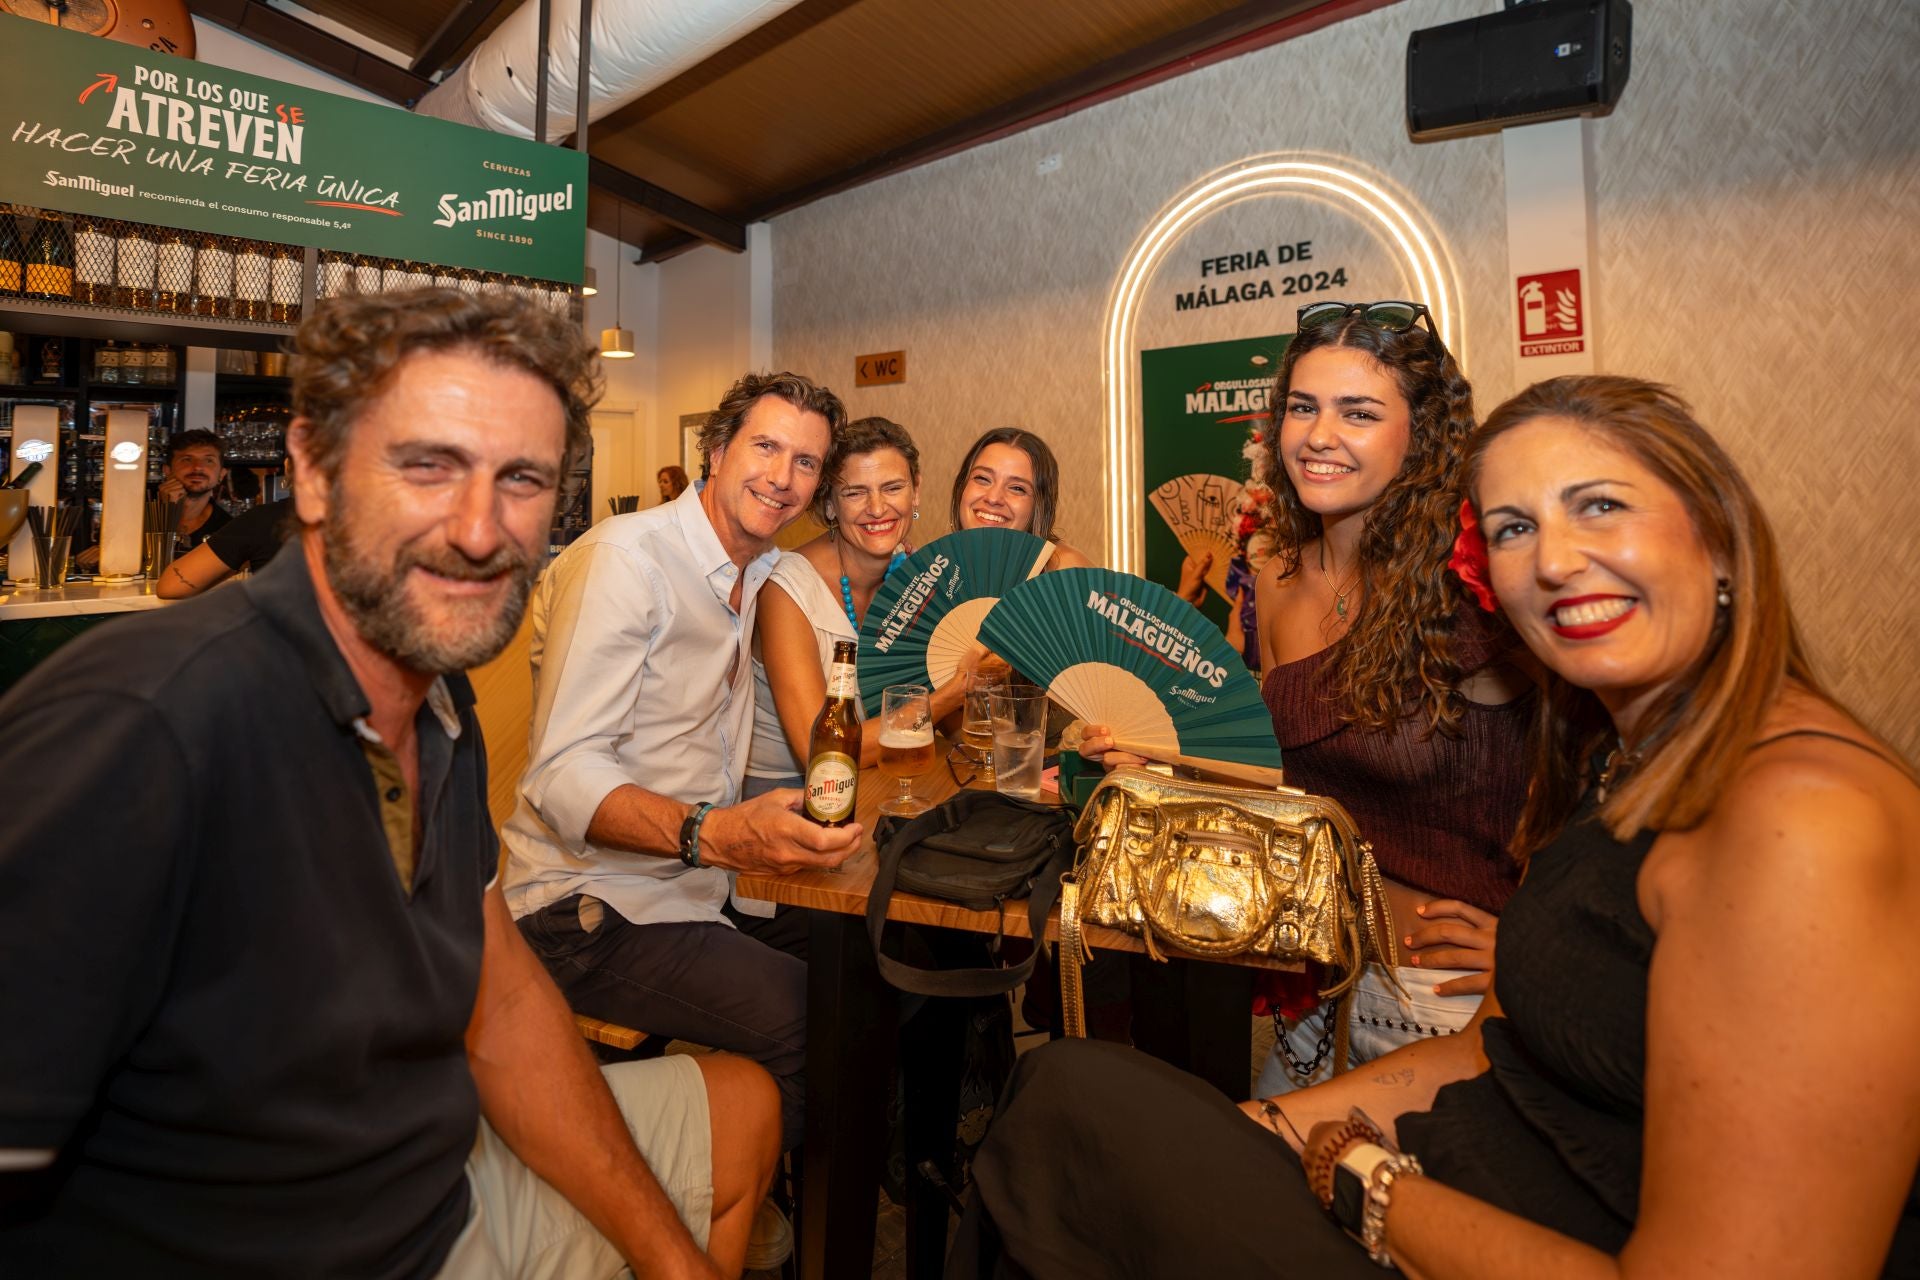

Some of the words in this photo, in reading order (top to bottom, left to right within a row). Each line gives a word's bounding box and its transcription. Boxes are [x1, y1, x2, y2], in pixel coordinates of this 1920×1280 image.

[134, 65, 179, 94] POR
[186, 77, 223, 103] LOS
[229, 88, 269, 113] QUE
[275, 104, 306, 124] SE
[106, 86, 304, 165] ATREVEN
[12, 121, 136, 164] HACER
[146, 148, 214, 175] UNA
[225, 162, 308, 192] FERIA
[482, 160, 531, 177] CERVEZAS
[43, 170, 134, 197] SanMiguel
[139, 190, 205, 208] recomienda
[208, 200, 219, 210] el
[222, 203, 269, 218] consumo
[272, 211, 331, 228] responsable
[433, 183, 573, 228] SanMiguel
[476, 229, 506, 241] SINCE
[508, 234, 533, 246] 1890
[1201, 249, 1270, 278] FERIA
[1278, 241, 1313, 265] DE
[1175, 279, 1275, 312] MÁLAGA
[1282, 267, 1348, 296] 2024
[874, 358, 897, 377] WC
[1524, 342, 1580, 355] EXTINTOR
[1213, 378, 1278, 391] ORGULLOSAM
[875, 554, 950, 654] MALAGUEÑOS
[881, 575, 920, 627] ORGULLOSAMENTE
[1120, 597, 1195, 648] ORGULLOSAMENTE
[1087, 590, 1228, 688] MALAGUEÑOS
[1169, 685, 1217, 704] SanMiguel
[807, 777, 856, 800] SanMigue
